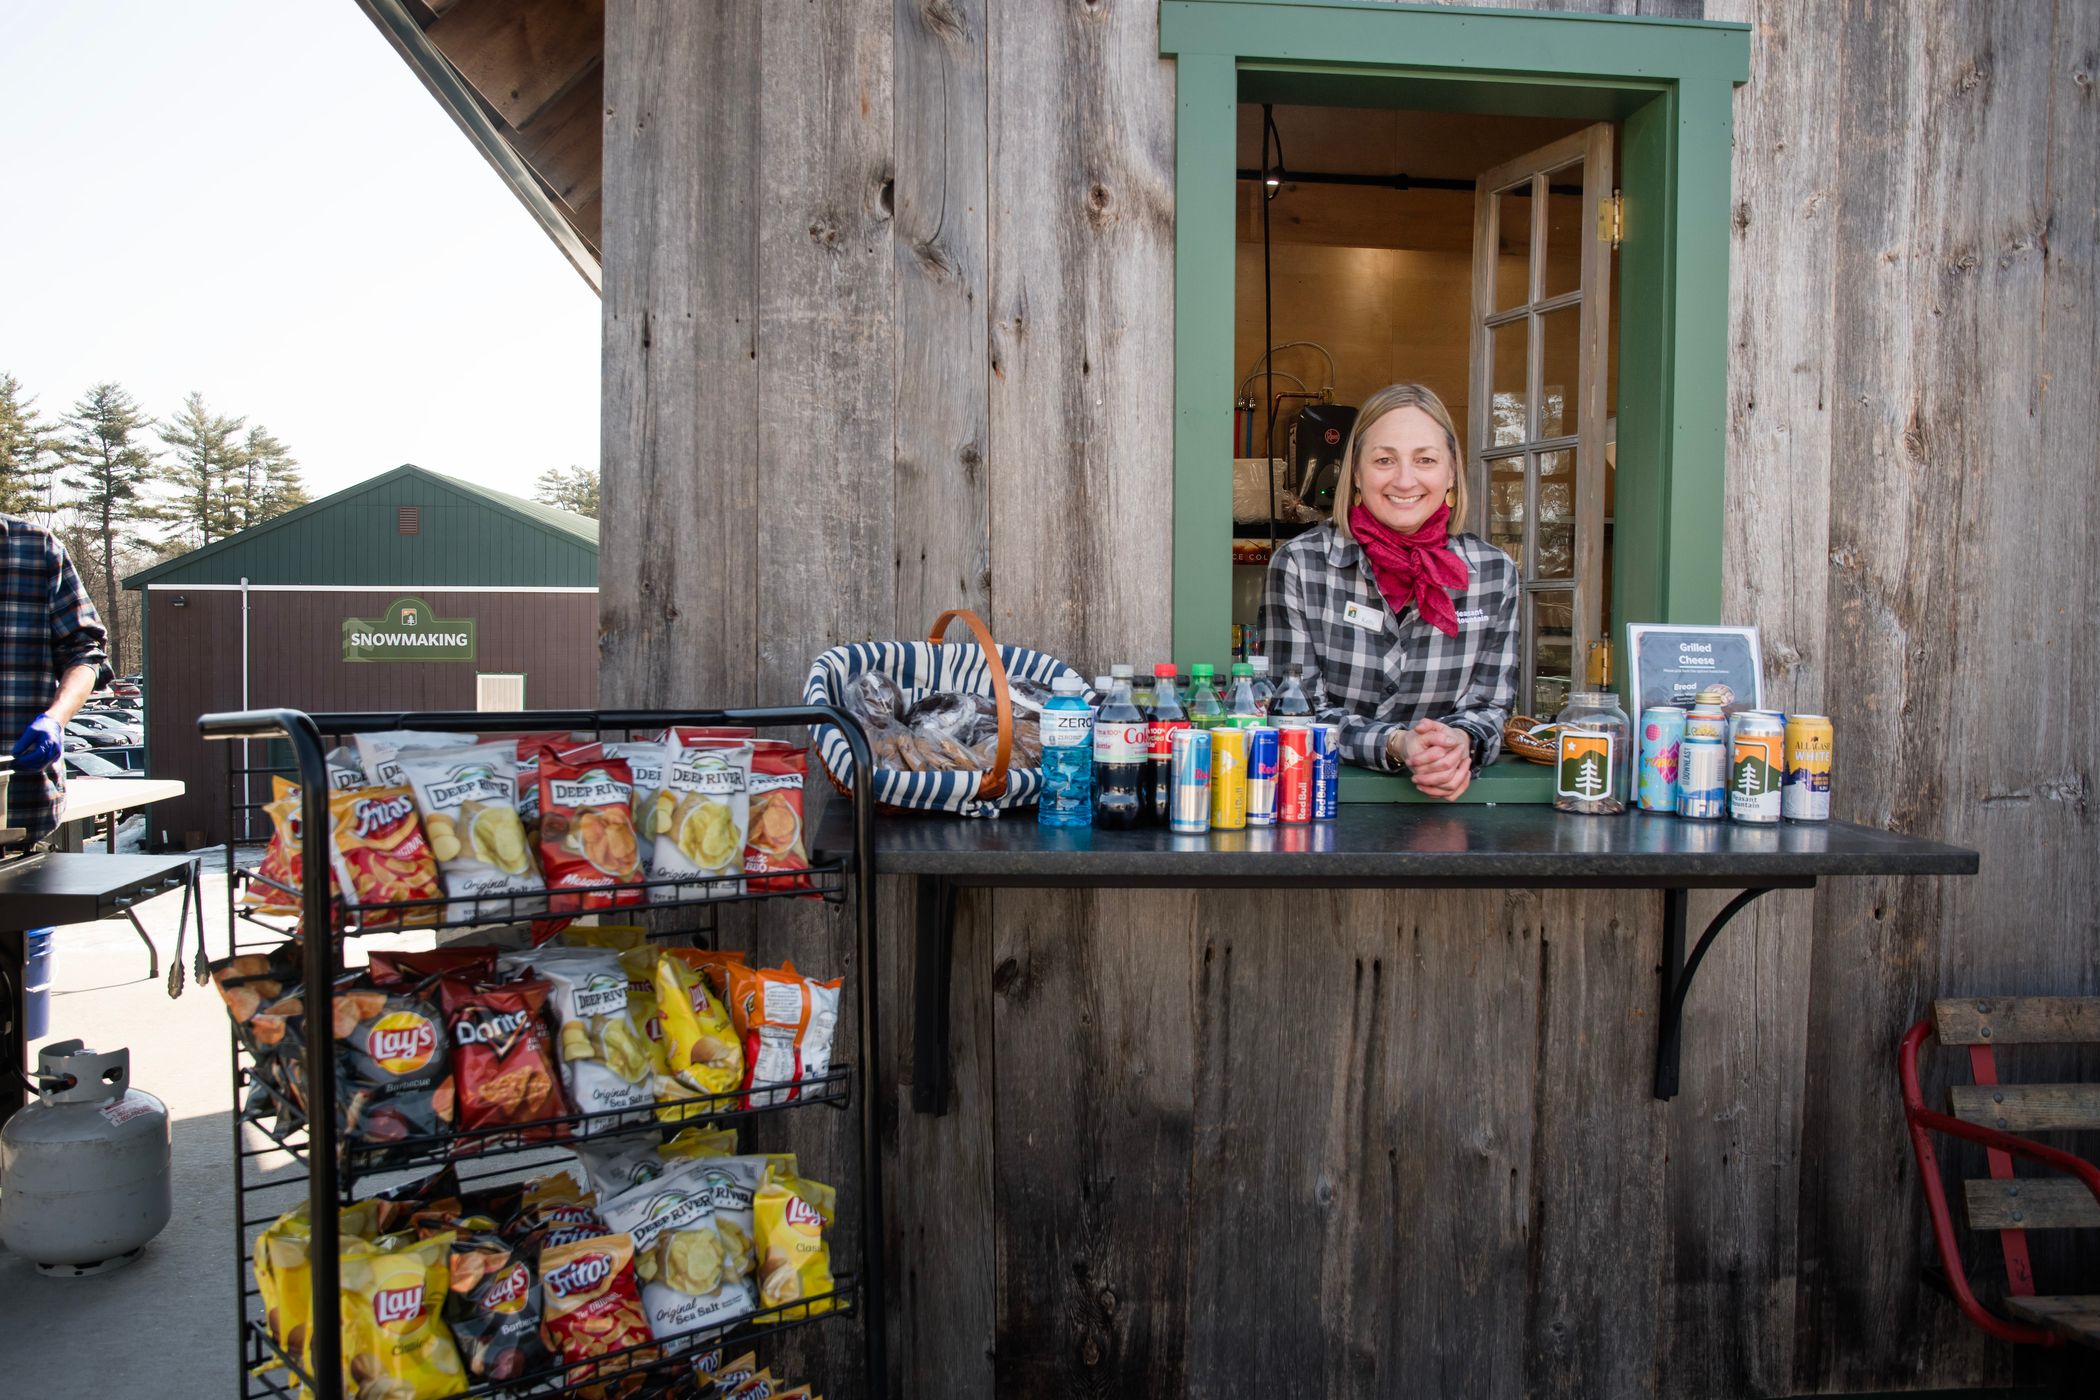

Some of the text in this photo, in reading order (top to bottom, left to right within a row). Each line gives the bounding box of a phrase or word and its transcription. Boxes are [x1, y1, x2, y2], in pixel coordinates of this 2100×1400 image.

[351, 633, 468, 646] SNOWMAKING
[1679, 642, 1712, 653] Grilled
[1678, 655, 1715, 665] Cheese
[1673, 682, 1697, 691] Bread
[1058, 717, 1093, 728] ZERO
[1795, 751, 1830, 762] WHITE
[673, 768, 704, 783] DEEP
[706, 771, 743, 786] RIVER
[755, 774, 801, 786] RIVER
[433, 782, 476, 802] DEEP
[556, 785, 593, 799] DEEP
[1316, 780, 1327, 818] Red Bull
[1297, 782, 1307, 820] Red Bull
[560, 873, 615, 887] Mesquite
[657, 867, 702, 882] Original
[463, 876, 510, 896] Original
[578, 993, 601, 1009] DEEP
[374, 1023, 432, 1060] Lay's
[385, 1078, 432, 1092] Barbecue
[593, 1085, 632, 1104] Original
[633, 1194, 714, 1243] DEEP RIVER
[544, 1254, 612, 1298] Fritos
[484, 1268, 525, 1307] Lay's
[656, 1297, 698, 1324] Original
[675, 1302, 721, 1325] Sea Salt
